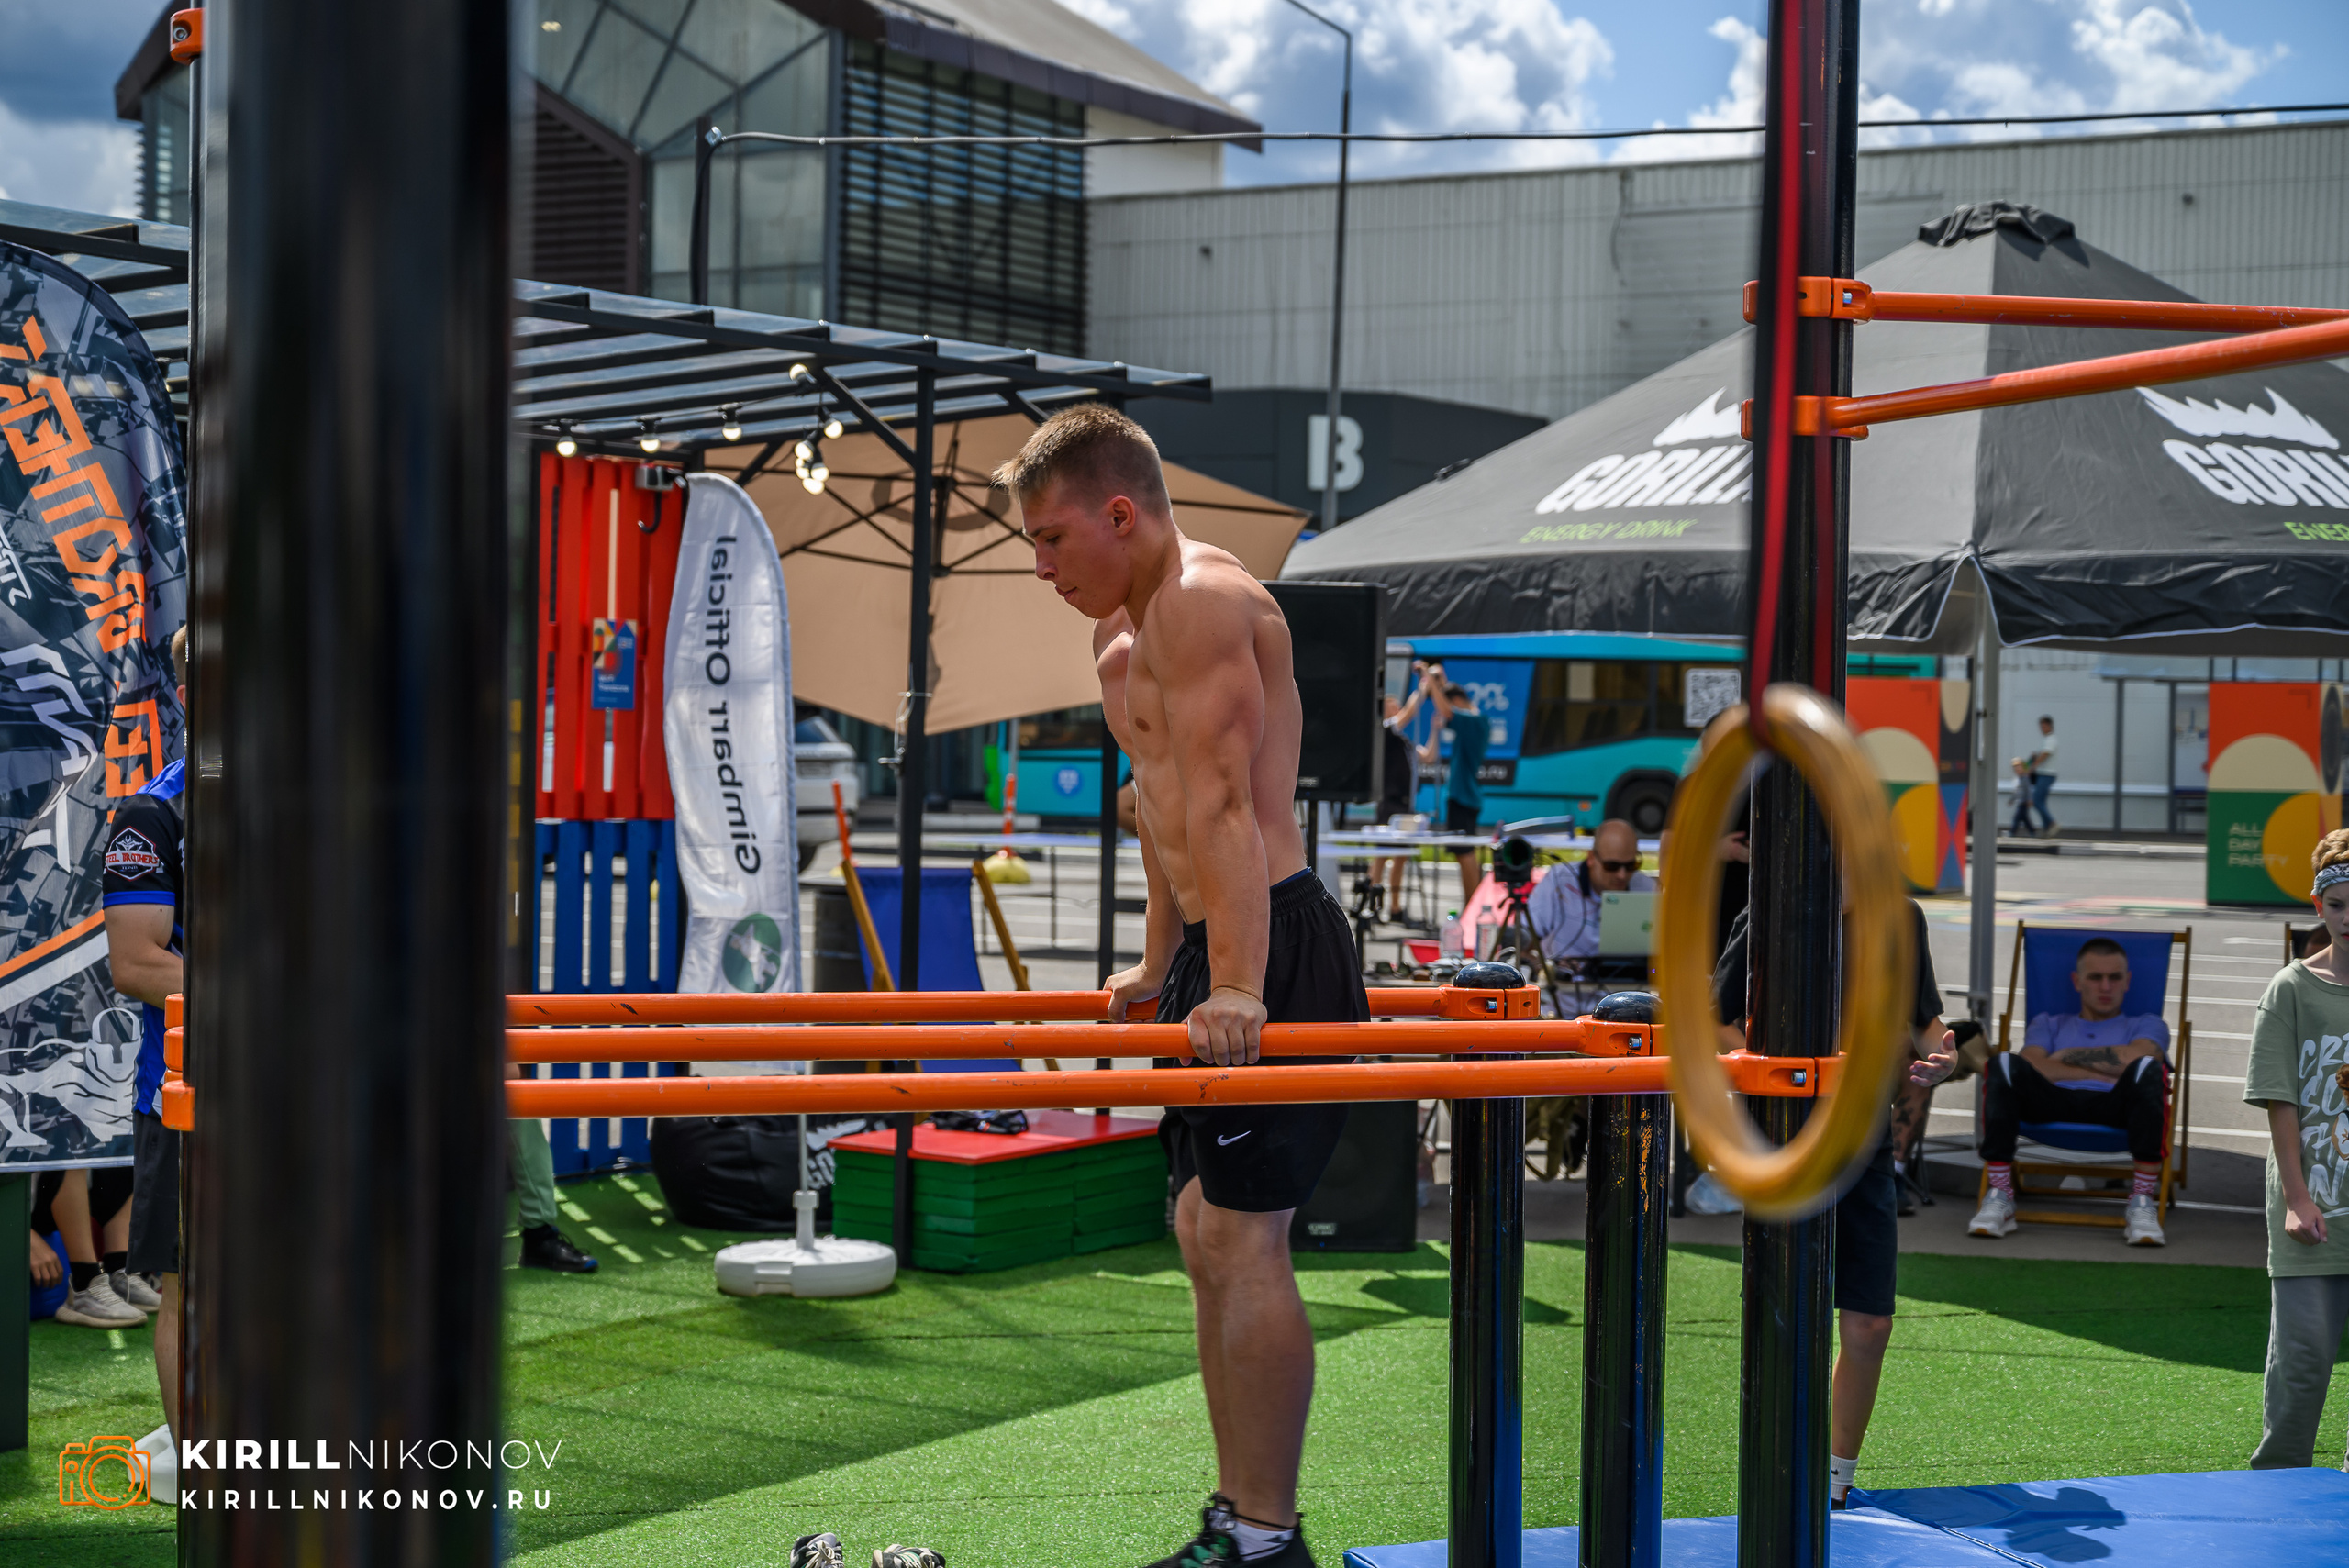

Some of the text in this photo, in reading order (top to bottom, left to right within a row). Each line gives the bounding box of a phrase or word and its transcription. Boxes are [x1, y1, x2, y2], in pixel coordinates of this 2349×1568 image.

[1519, 518, 1698, 543] ENERGY DRINK
[2230, 822, 2263, 837] ALL
[122, 853, 160, 864] BROTHERS
[2228, 853, 2288, 867] PARTY
